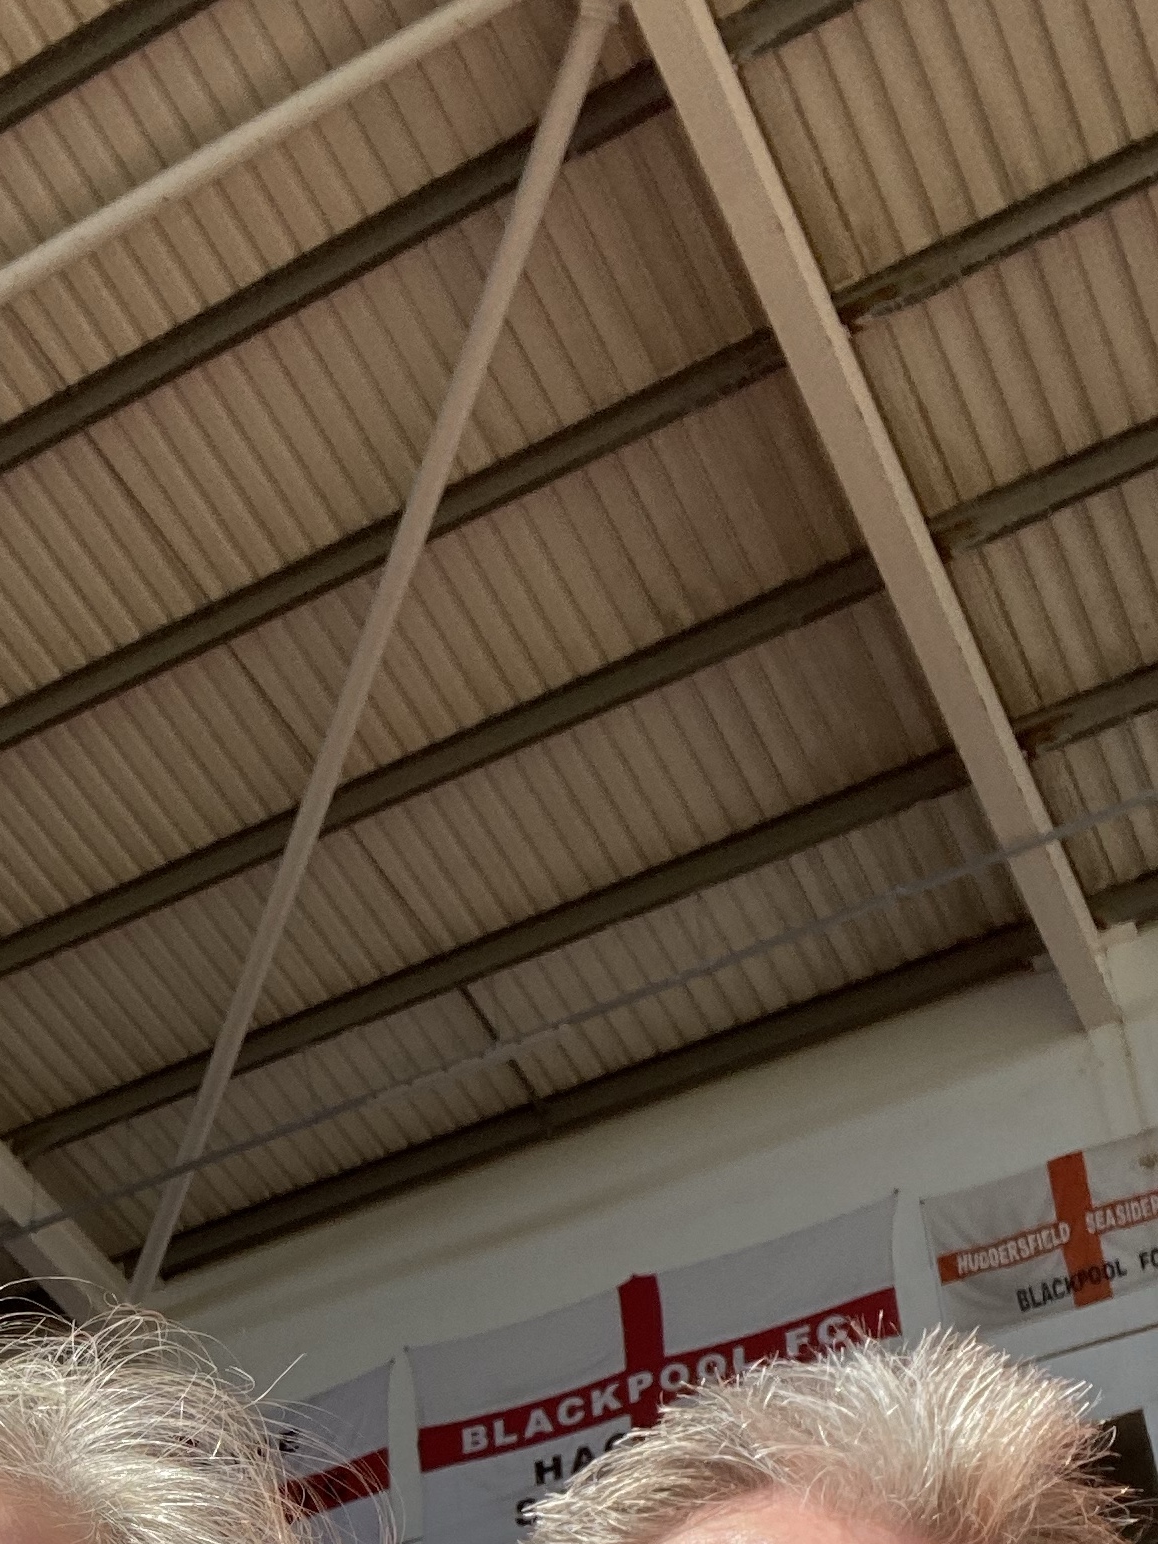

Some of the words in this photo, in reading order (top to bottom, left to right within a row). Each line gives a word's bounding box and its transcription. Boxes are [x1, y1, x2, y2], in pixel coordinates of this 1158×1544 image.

[956, 1222, 1072, 1276] HUDDERSFIELD
[1015, 1258, 1128, 1313] BLACKPOOL
[461, 1344, 752, 1455] BLACKPOOL
